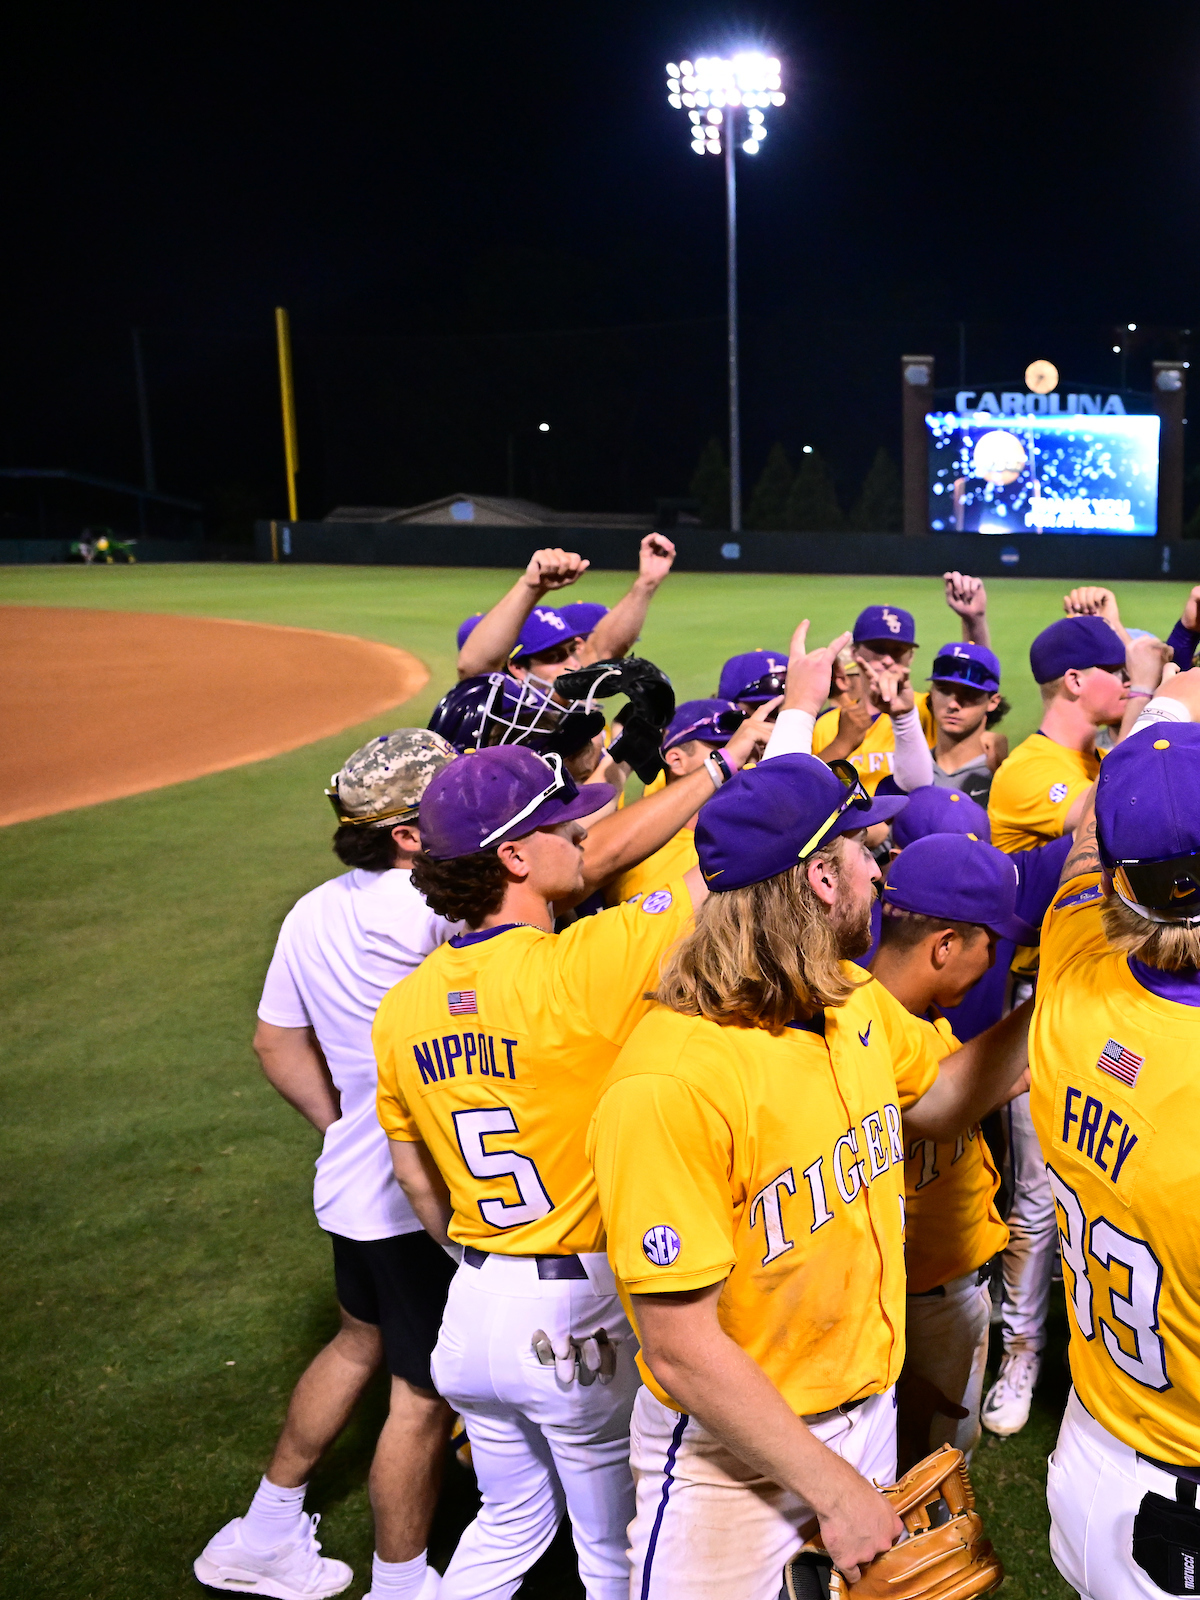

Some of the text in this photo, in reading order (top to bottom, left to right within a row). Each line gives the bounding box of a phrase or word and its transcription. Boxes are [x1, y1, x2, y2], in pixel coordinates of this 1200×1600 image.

[956, 391, 1126, 415] CAROLINA
[534, 609, 565, 630] LSU
[882, 609, 902, 634] LSU
[413, 1032, 518, 1085] NIPPOLT
[1062, 1086, 1139, 1184] FREY
[451, 1107, 555, 1229] 5
[750, 1103, 904, 1268] TIGER
[642, 1225, 681, 1266] SEC
[1046, 1161, 1174, 1393] 33
[1181, 1552, 1195, 1590] marucci
